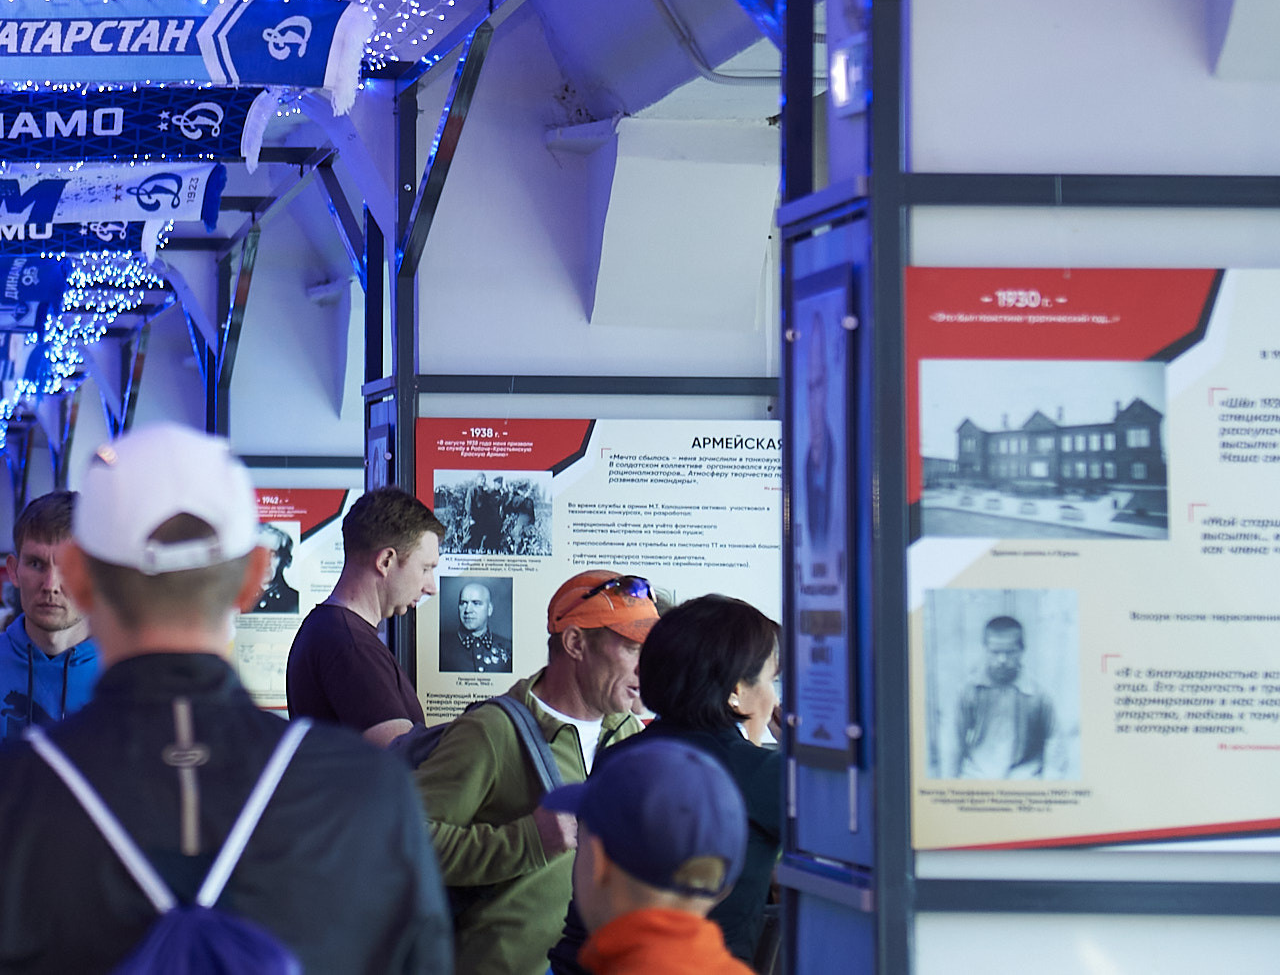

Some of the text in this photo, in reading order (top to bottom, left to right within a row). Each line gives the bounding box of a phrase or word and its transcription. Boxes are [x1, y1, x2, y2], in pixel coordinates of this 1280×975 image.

[186, 177, 199, 204] 1923
[5, 258, 27, 300] ДИНАМО
[470, 428, 493, 438] 1938
[688, 470, 728, 478] Атмосферу
